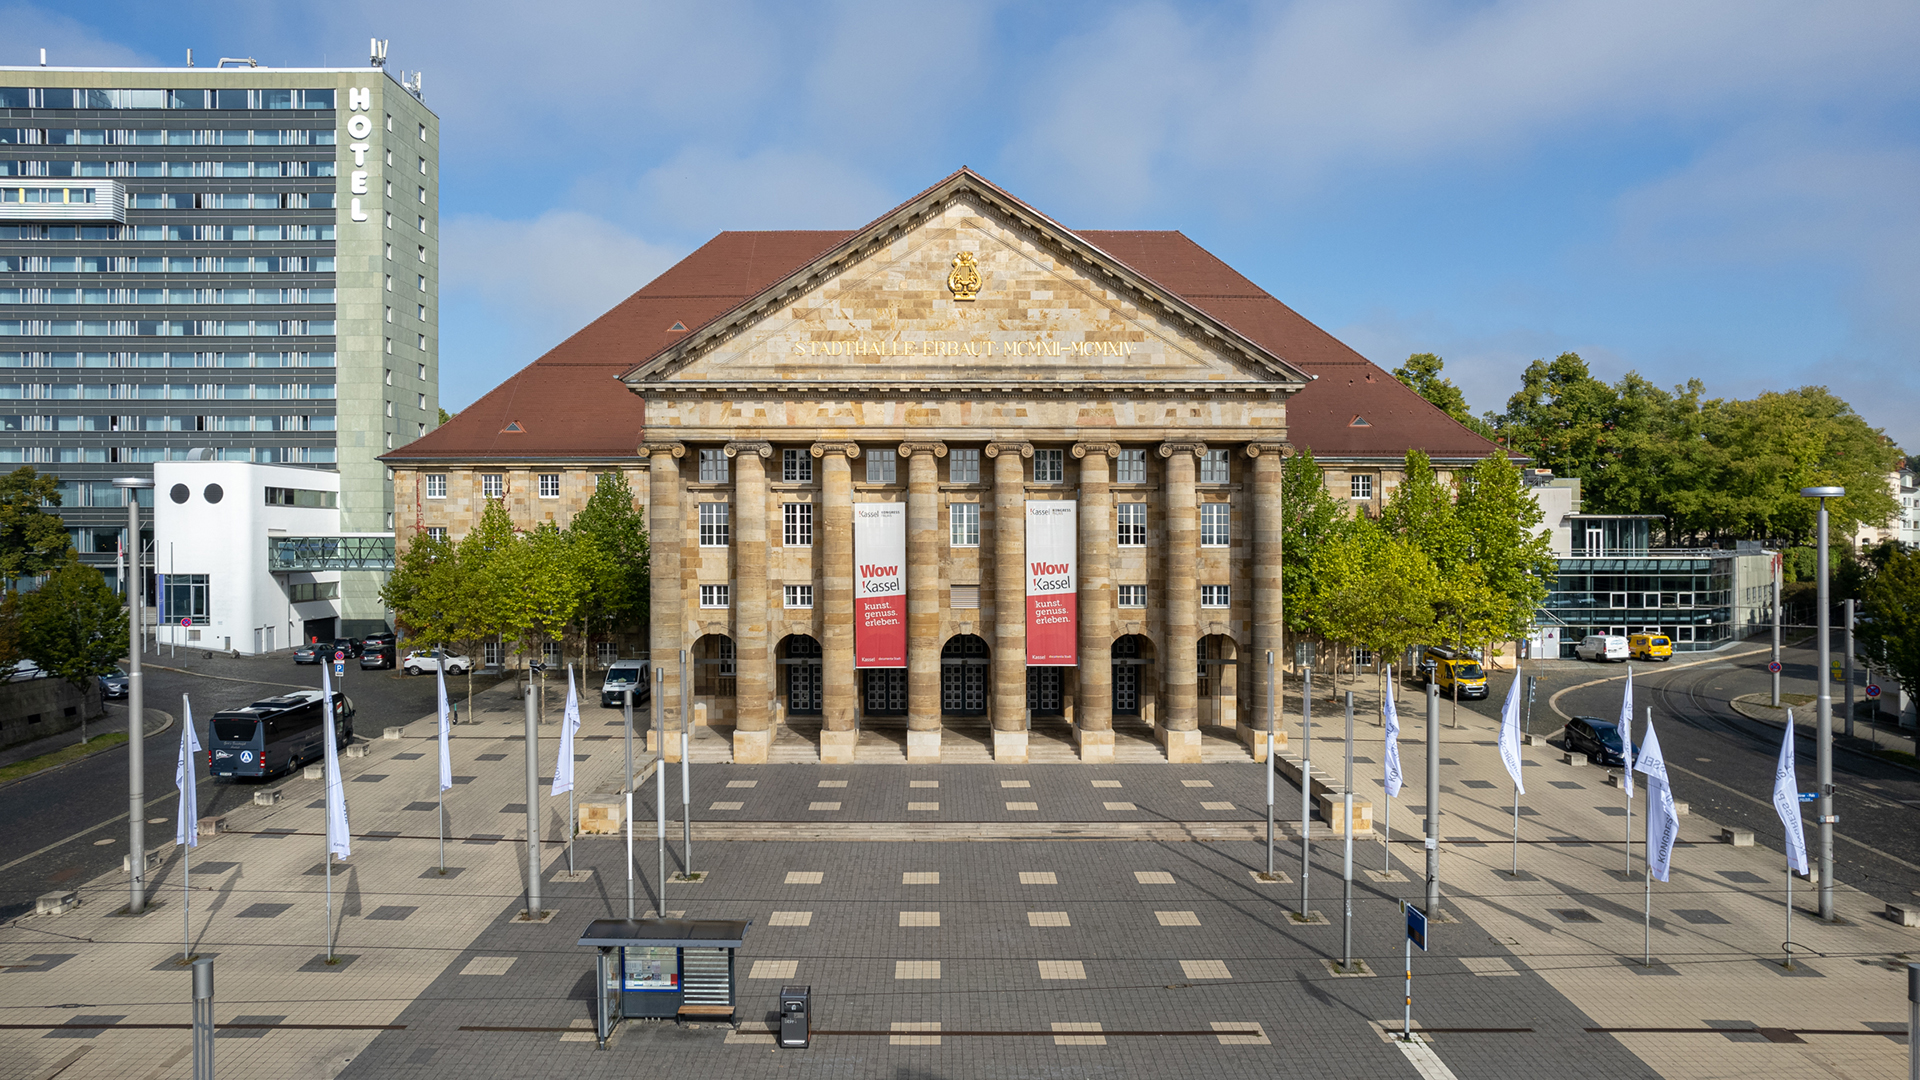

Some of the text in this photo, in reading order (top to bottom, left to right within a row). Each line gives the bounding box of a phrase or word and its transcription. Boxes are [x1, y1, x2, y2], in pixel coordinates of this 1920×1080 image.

[347, 87, 372, 222] HOTEL
[860, 564, 898, 578] Wow
[1031, 562, 1069, 576] Wow
[864, 602, 891, 610] kunst.
[1035, 600, 1062, 608] kunst.
[864, 610, 898, 620] genuss.
[1035, 608, 1069, 617] genuss.
[865, 618, 900, 627] erleben.
[1036, 616, 1071, 625] erleben.
